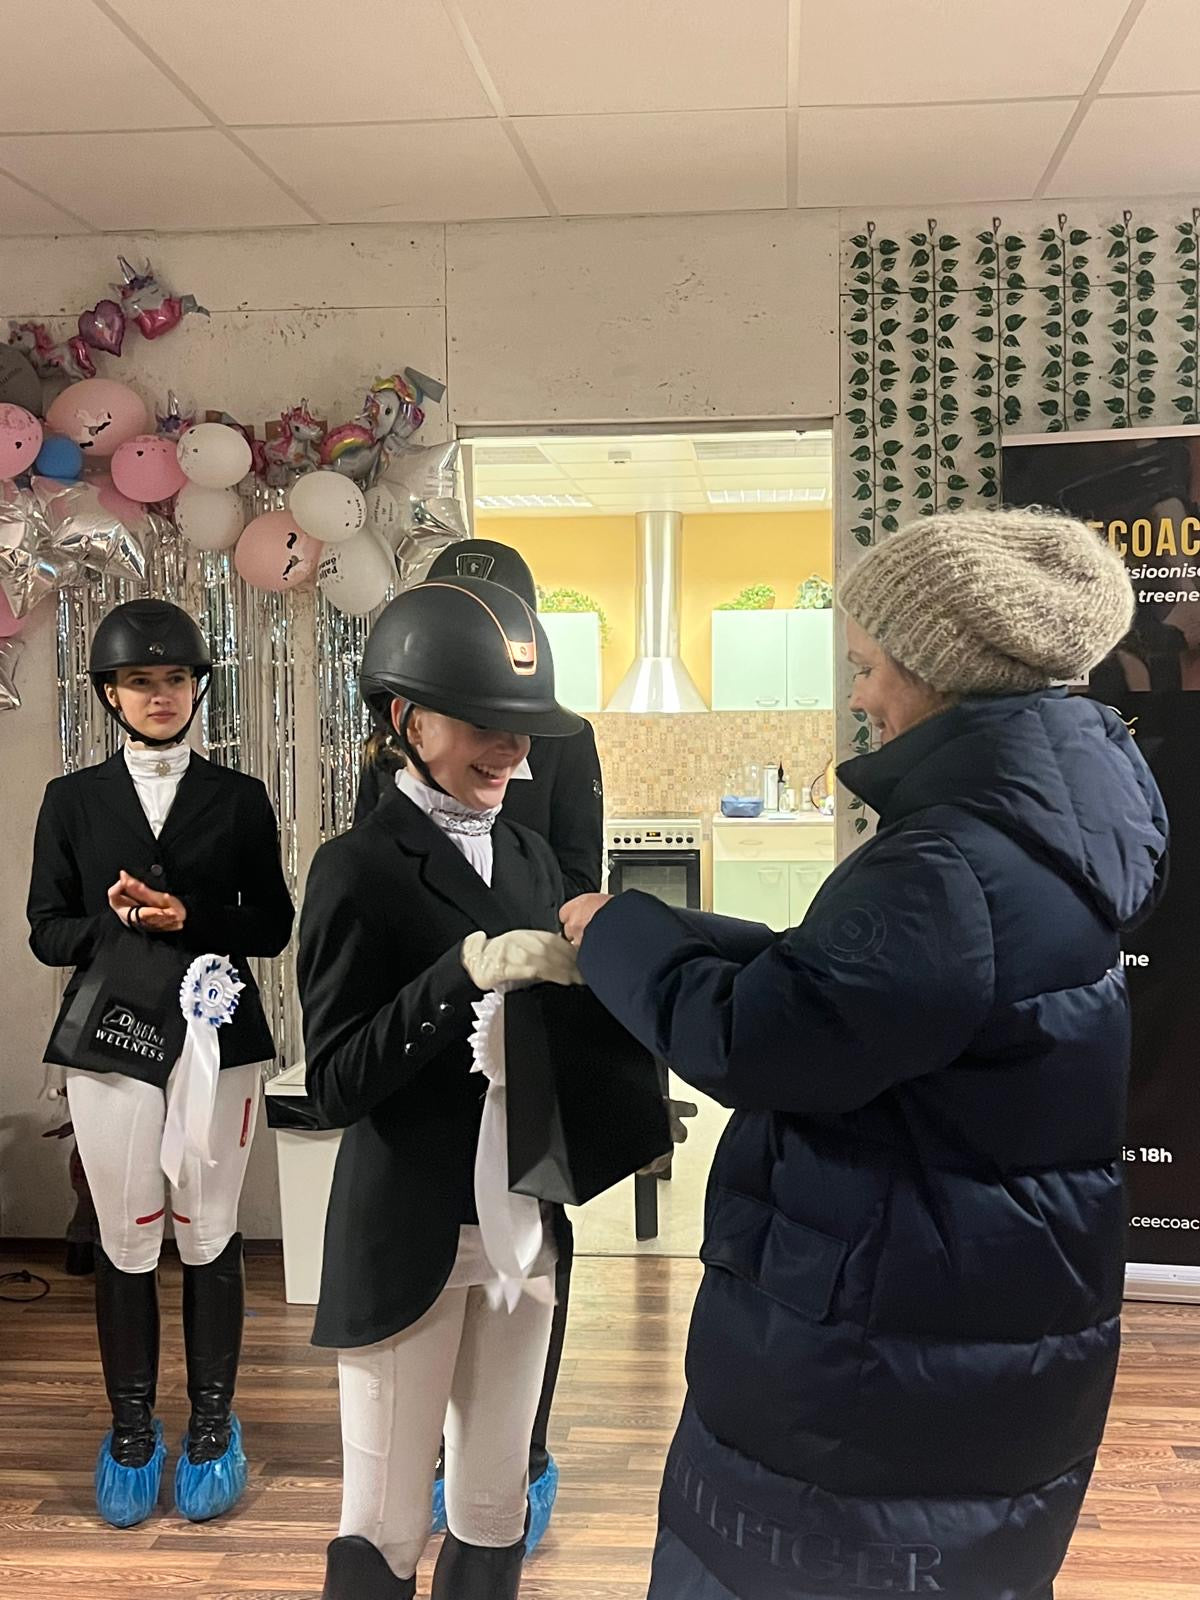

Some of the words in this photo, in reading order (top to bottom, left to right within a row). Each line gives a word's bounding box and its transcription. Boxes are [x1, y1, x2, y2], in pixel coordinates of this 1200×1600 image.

[1087, 516, 1200, 558] COAC
[1126, 563, 1200, 580] sioonis
[1138, 590, 1200, 603] treene
[96, 1029, 165, 1062] WELLNESS
[1122, 1146, 1136, 1162] is
[1139, 1147, 1173, 1163] 18h
